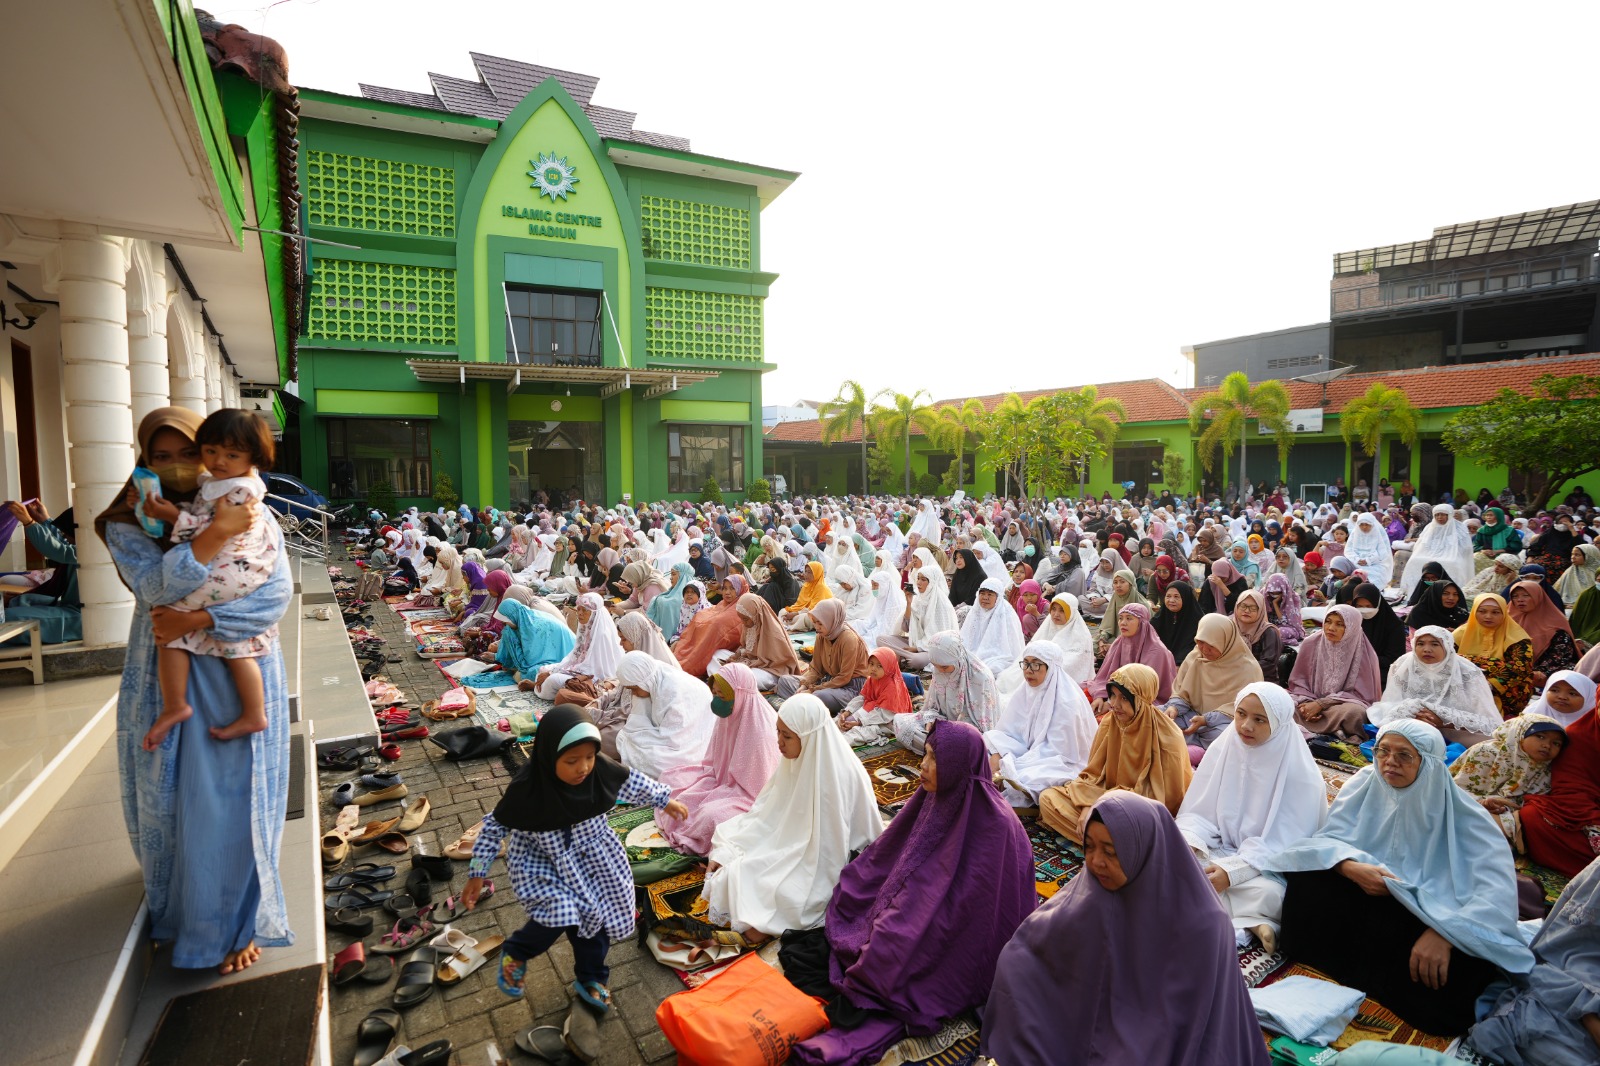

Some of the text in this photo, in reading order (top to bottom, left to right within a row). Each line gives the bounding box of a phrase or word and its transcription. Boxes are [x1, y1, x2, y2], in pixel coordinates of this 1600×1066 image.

[502, 205, 602, 227] ISLAMIC CENTRE
[528, 224, 577, 240] MADIUN
